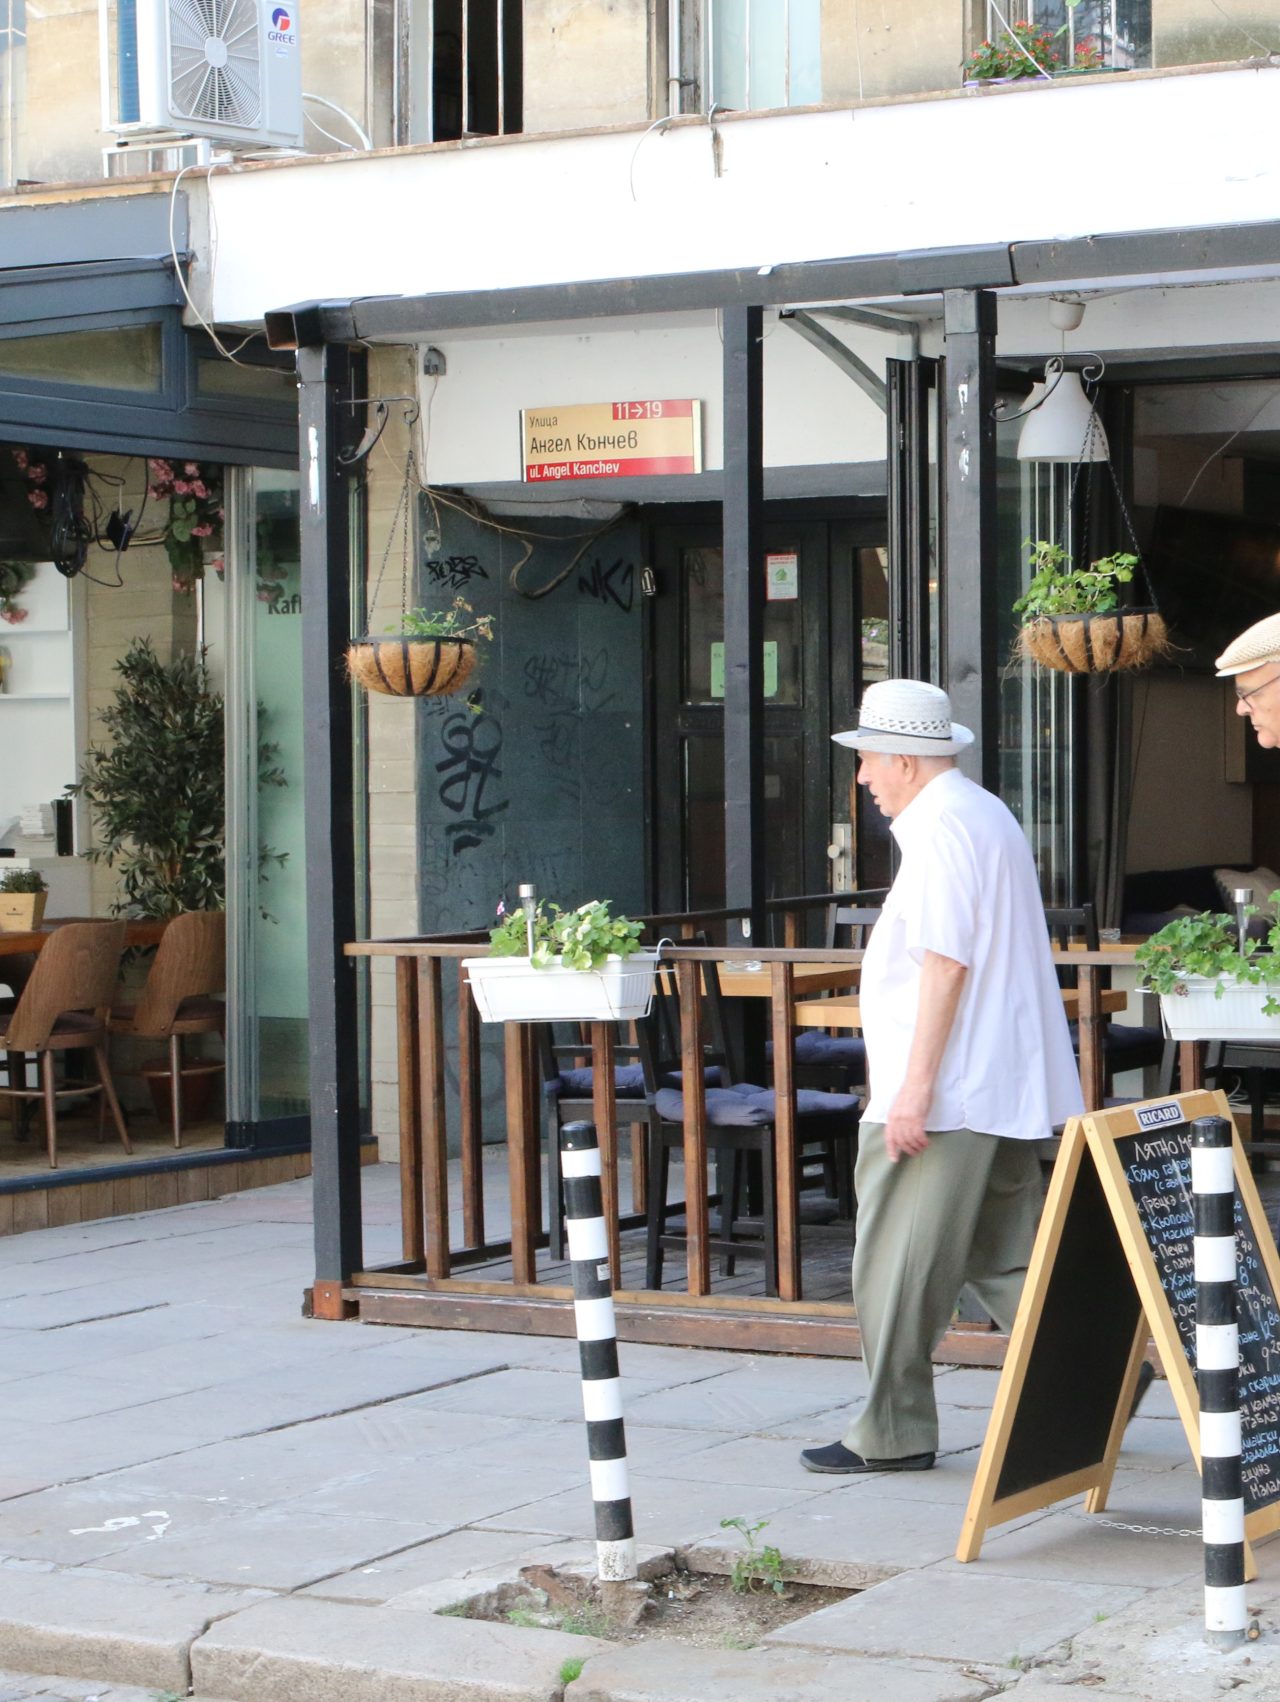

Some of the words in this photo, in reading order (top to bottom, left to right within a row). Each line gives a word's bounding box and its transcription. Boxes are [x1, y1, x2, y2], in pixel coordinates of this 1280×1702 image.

[267, 31, 296, 45] GREE
[529, 415, 558, 428] Улица
[530, 437, 572, 454] Ангел
[577, 430, 638, 451] Кънчев
[542, 464, 571, 480] Angel
[573, 461, 620, 475] Kanchev
[1140, 1106, 1180, 1126] RICARD
